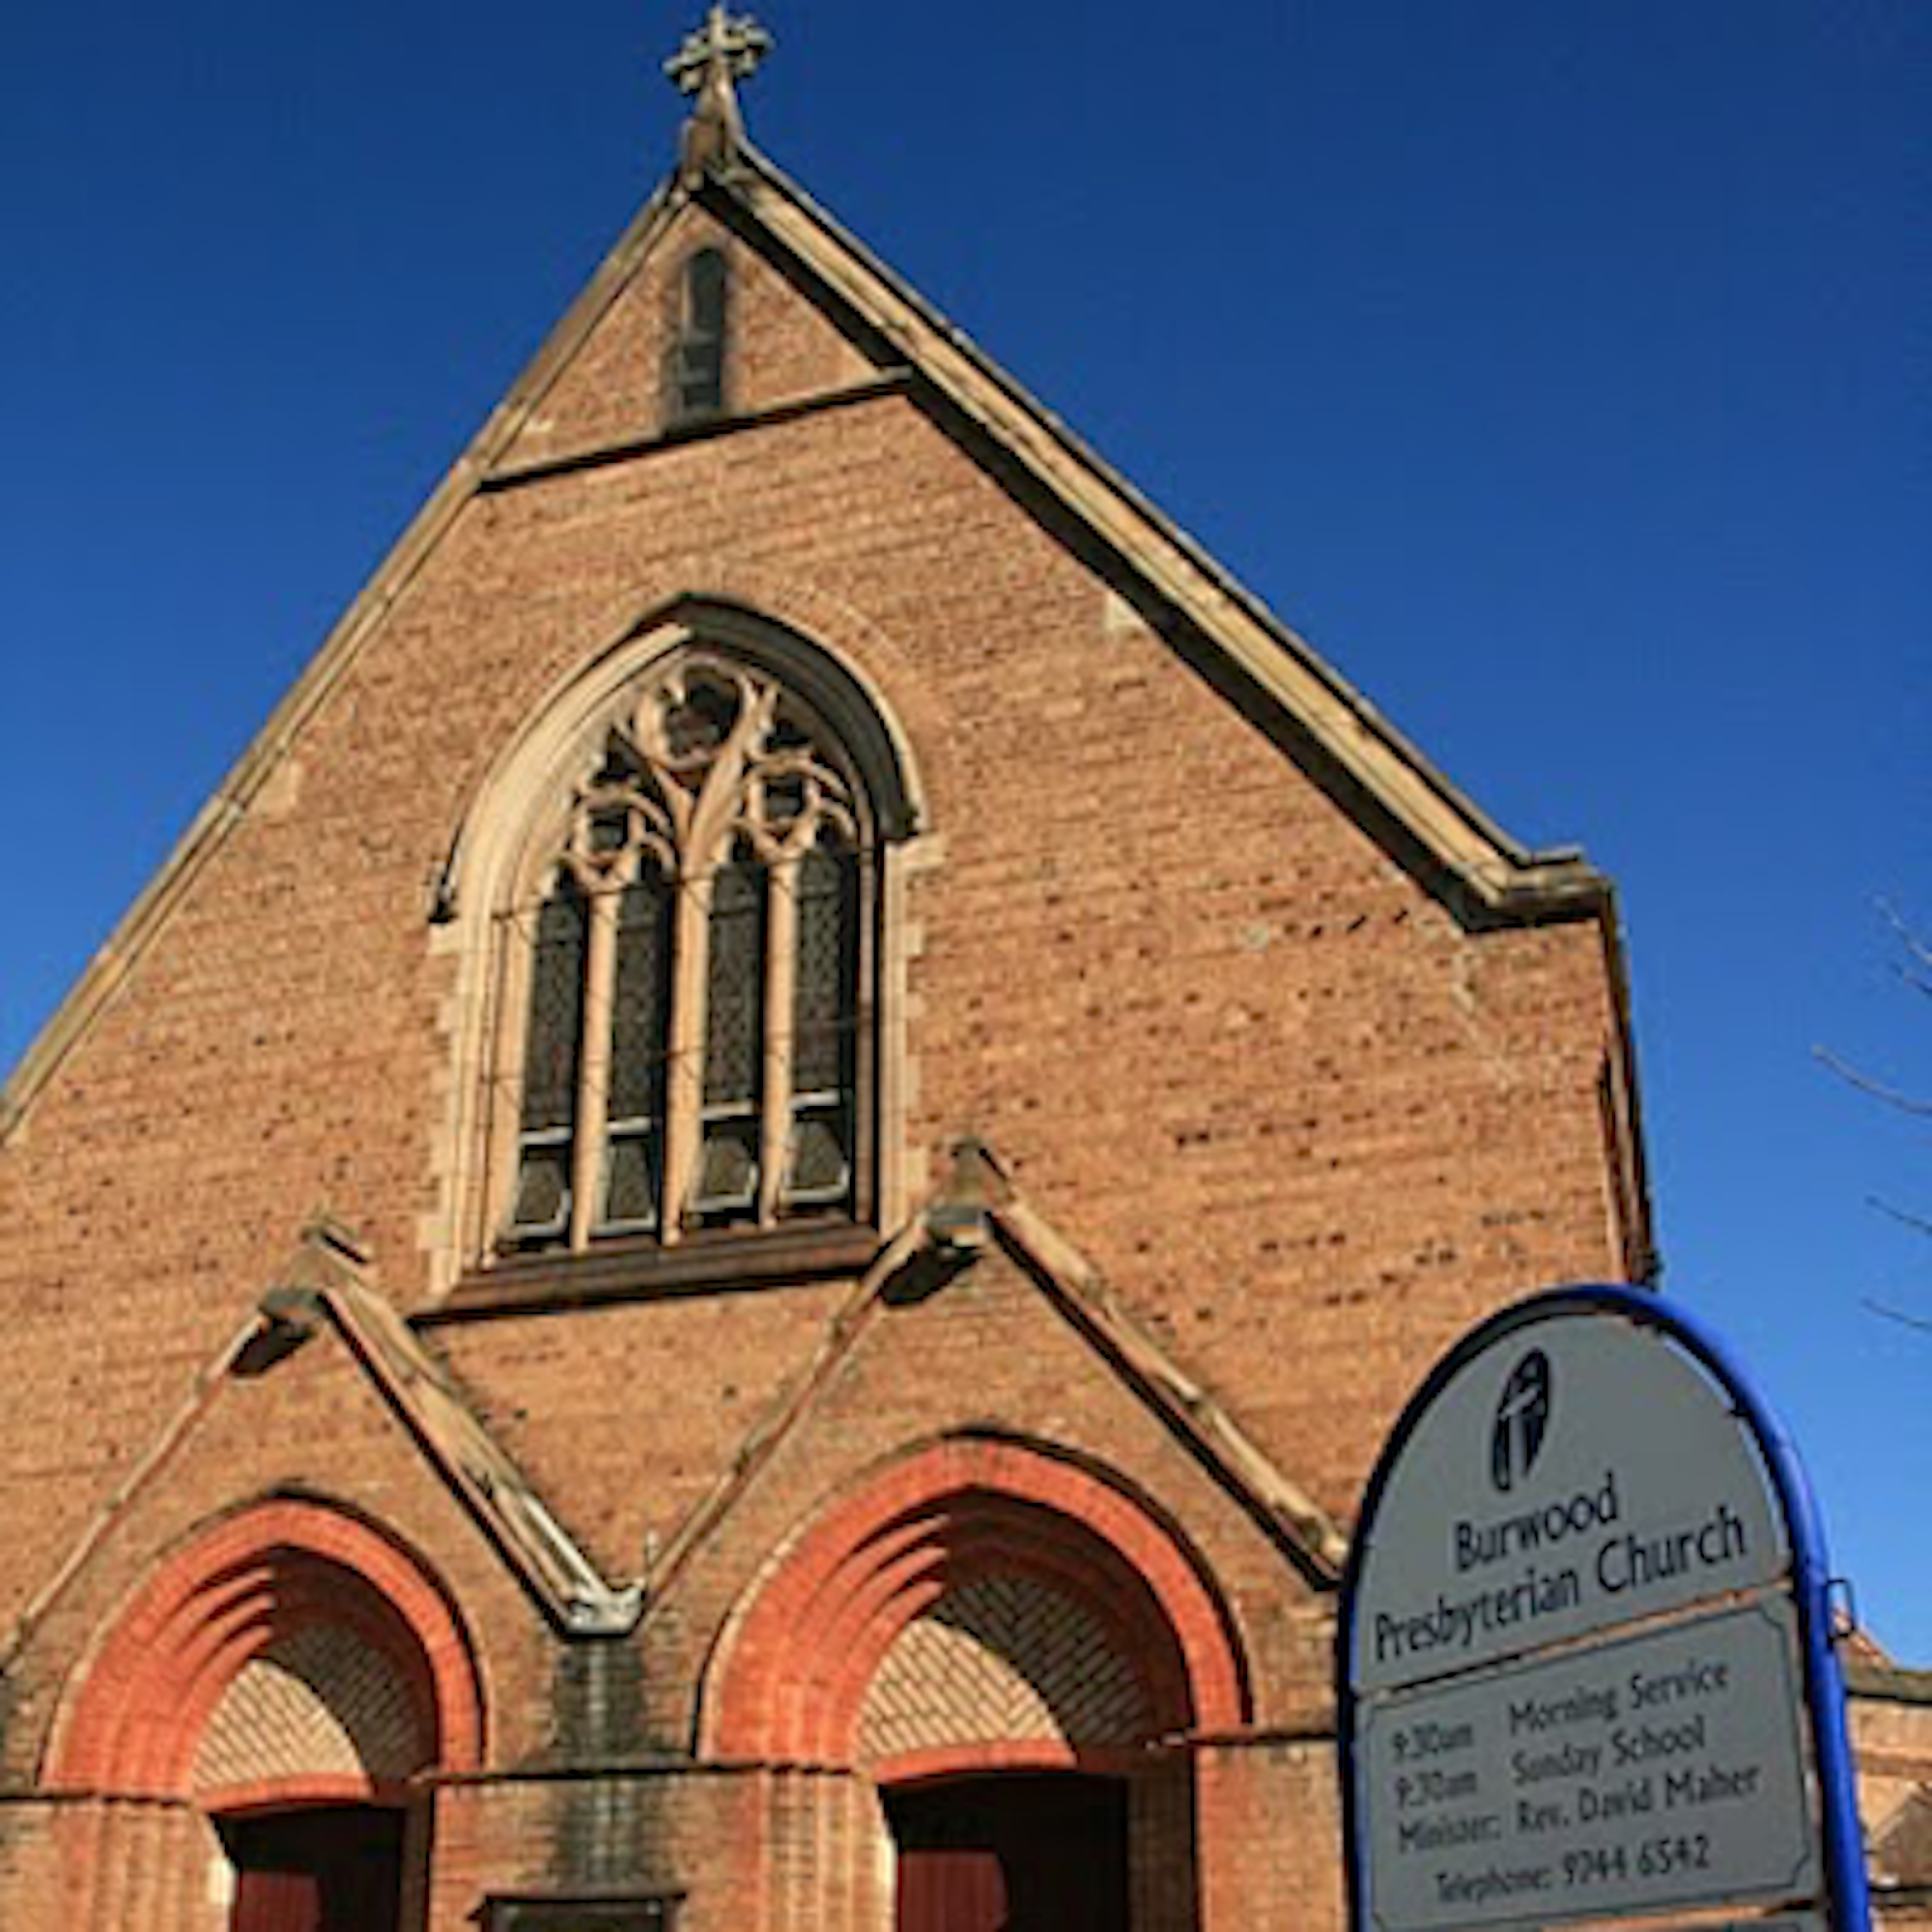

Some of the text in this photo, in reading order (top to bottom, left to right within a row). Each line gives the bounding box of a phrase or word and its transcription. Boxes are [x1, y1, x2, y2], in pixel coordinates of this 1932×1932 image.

[1455, 1469, 1619, 1573] Burwood
[1375, 1504, 1747, 1661] Presbyterian Church
[1510, 1688, 1618, 1736] Morning
[1631, 1660, 1729, 1710] Service
[1512, 1743, 1602, 1785] Sunday
[1612, 1714, 1705, 1766] School
[1578, 1781, 1652, 1823] David
